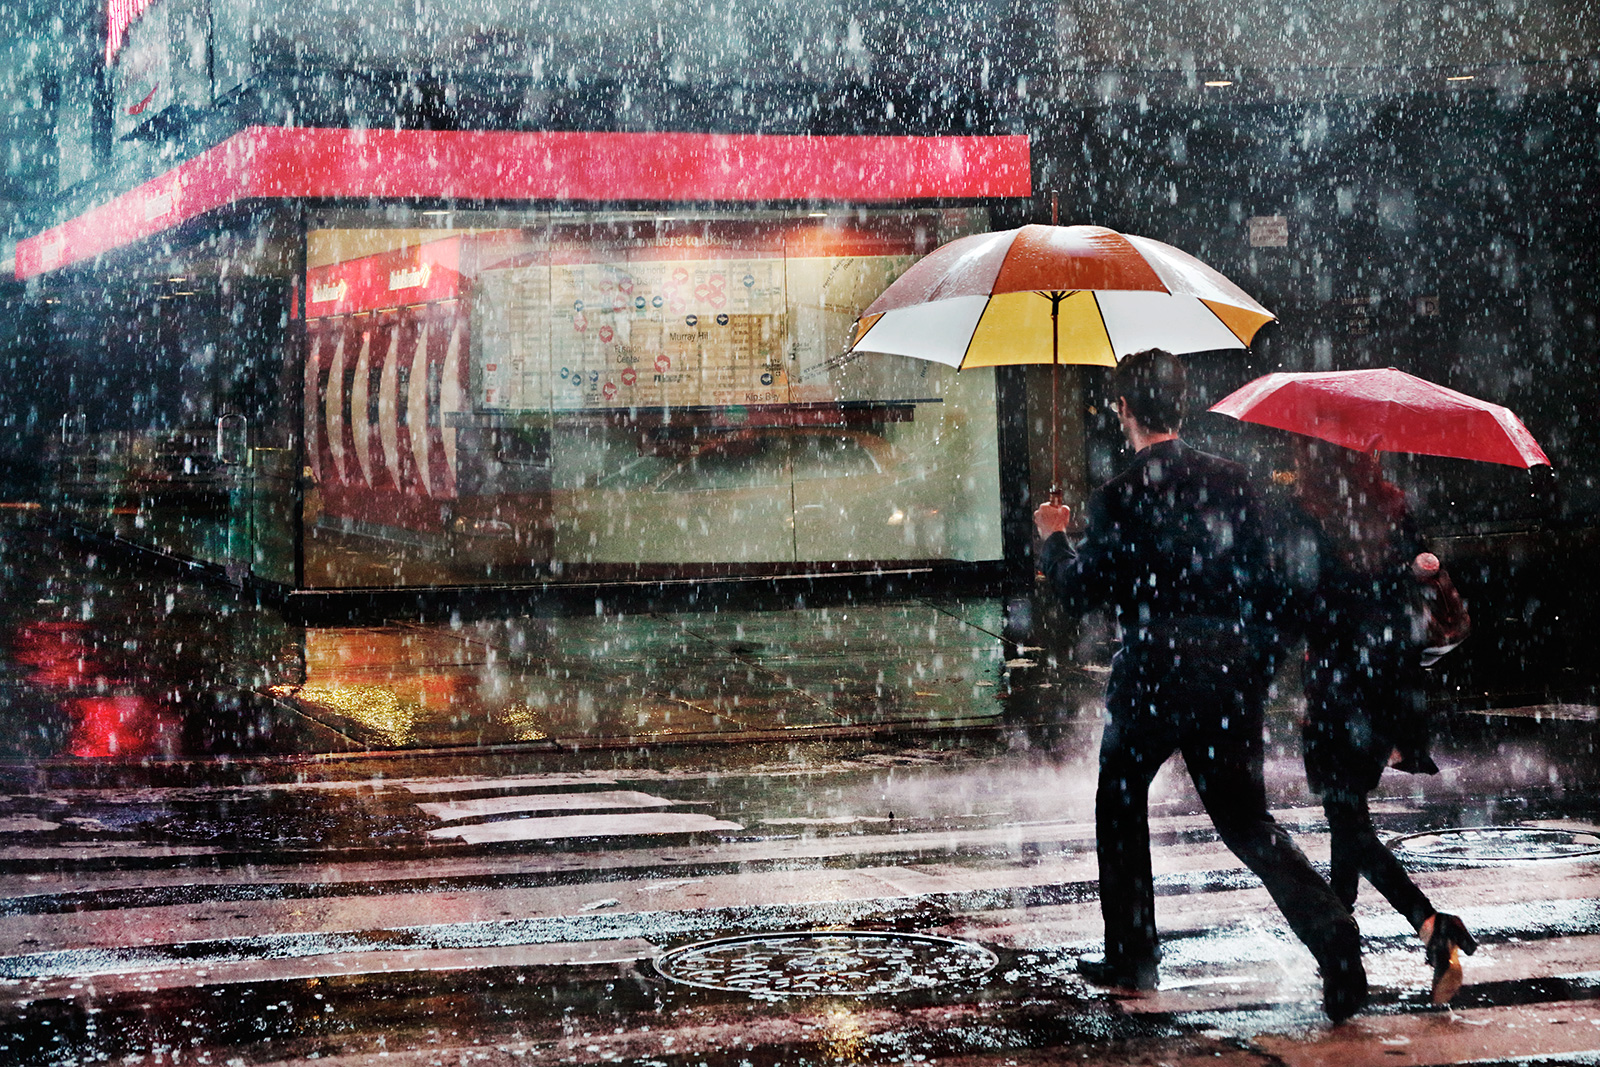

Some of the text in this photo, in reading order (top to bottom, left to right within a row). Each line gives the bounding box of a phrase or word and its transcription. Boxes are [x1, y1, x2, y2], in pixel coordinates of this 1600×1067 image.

[647, 235, 682, 247] where
[685, 234, 699, 245] to
[669, 331, 710, 343] Murray Hill
[614, 344, 642, 353] Fashion
[616, 355, 640, 364] Center
[745, 393, 763, 403] Kips
